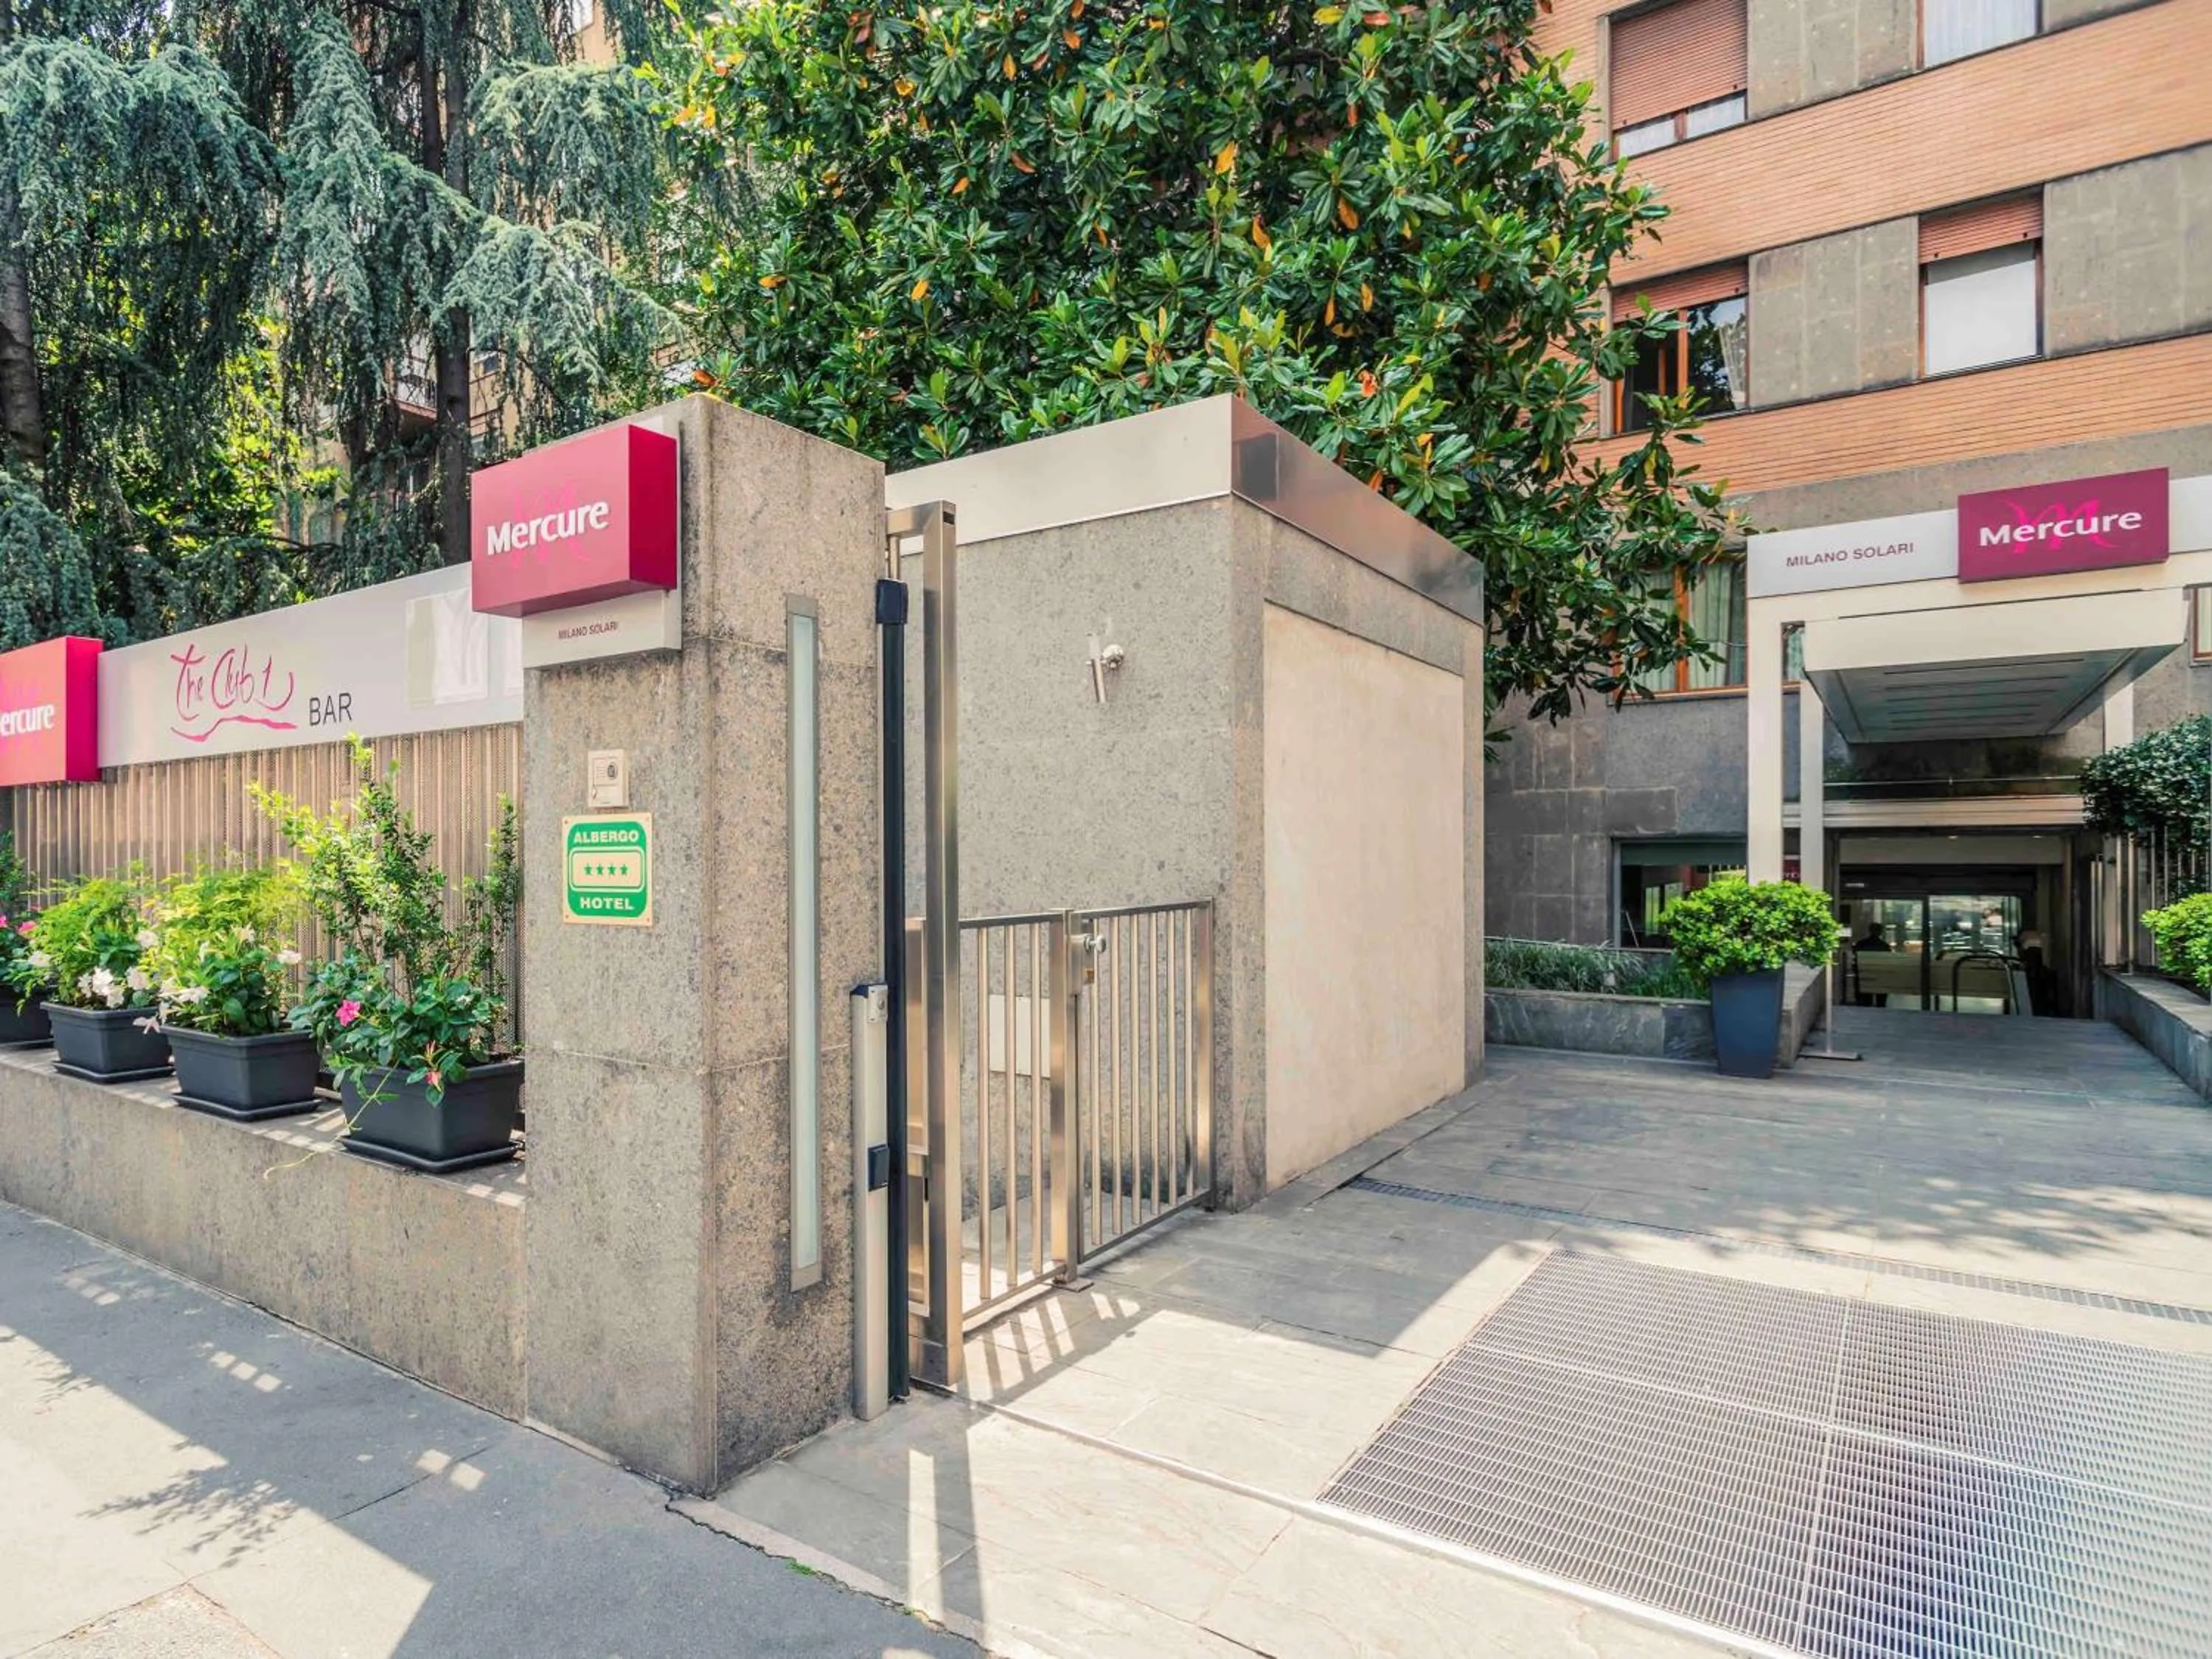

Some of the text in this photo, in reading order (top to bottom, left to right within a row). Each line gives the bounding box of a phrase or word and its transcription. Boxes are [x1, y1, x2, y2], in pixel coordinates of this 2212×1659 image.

[487, 501, 611, 556] Mercure
[1979, 511, 2143, 546] Mercure
[1787, 542, 1914, 567] MILANO SOLARI
[0, 703, 55, 737] ercure
[308, 692, 352, 727] BAR
[574, 829, 639, 844] ALBERGO
[580, 897, 635, 911] HOTEL
